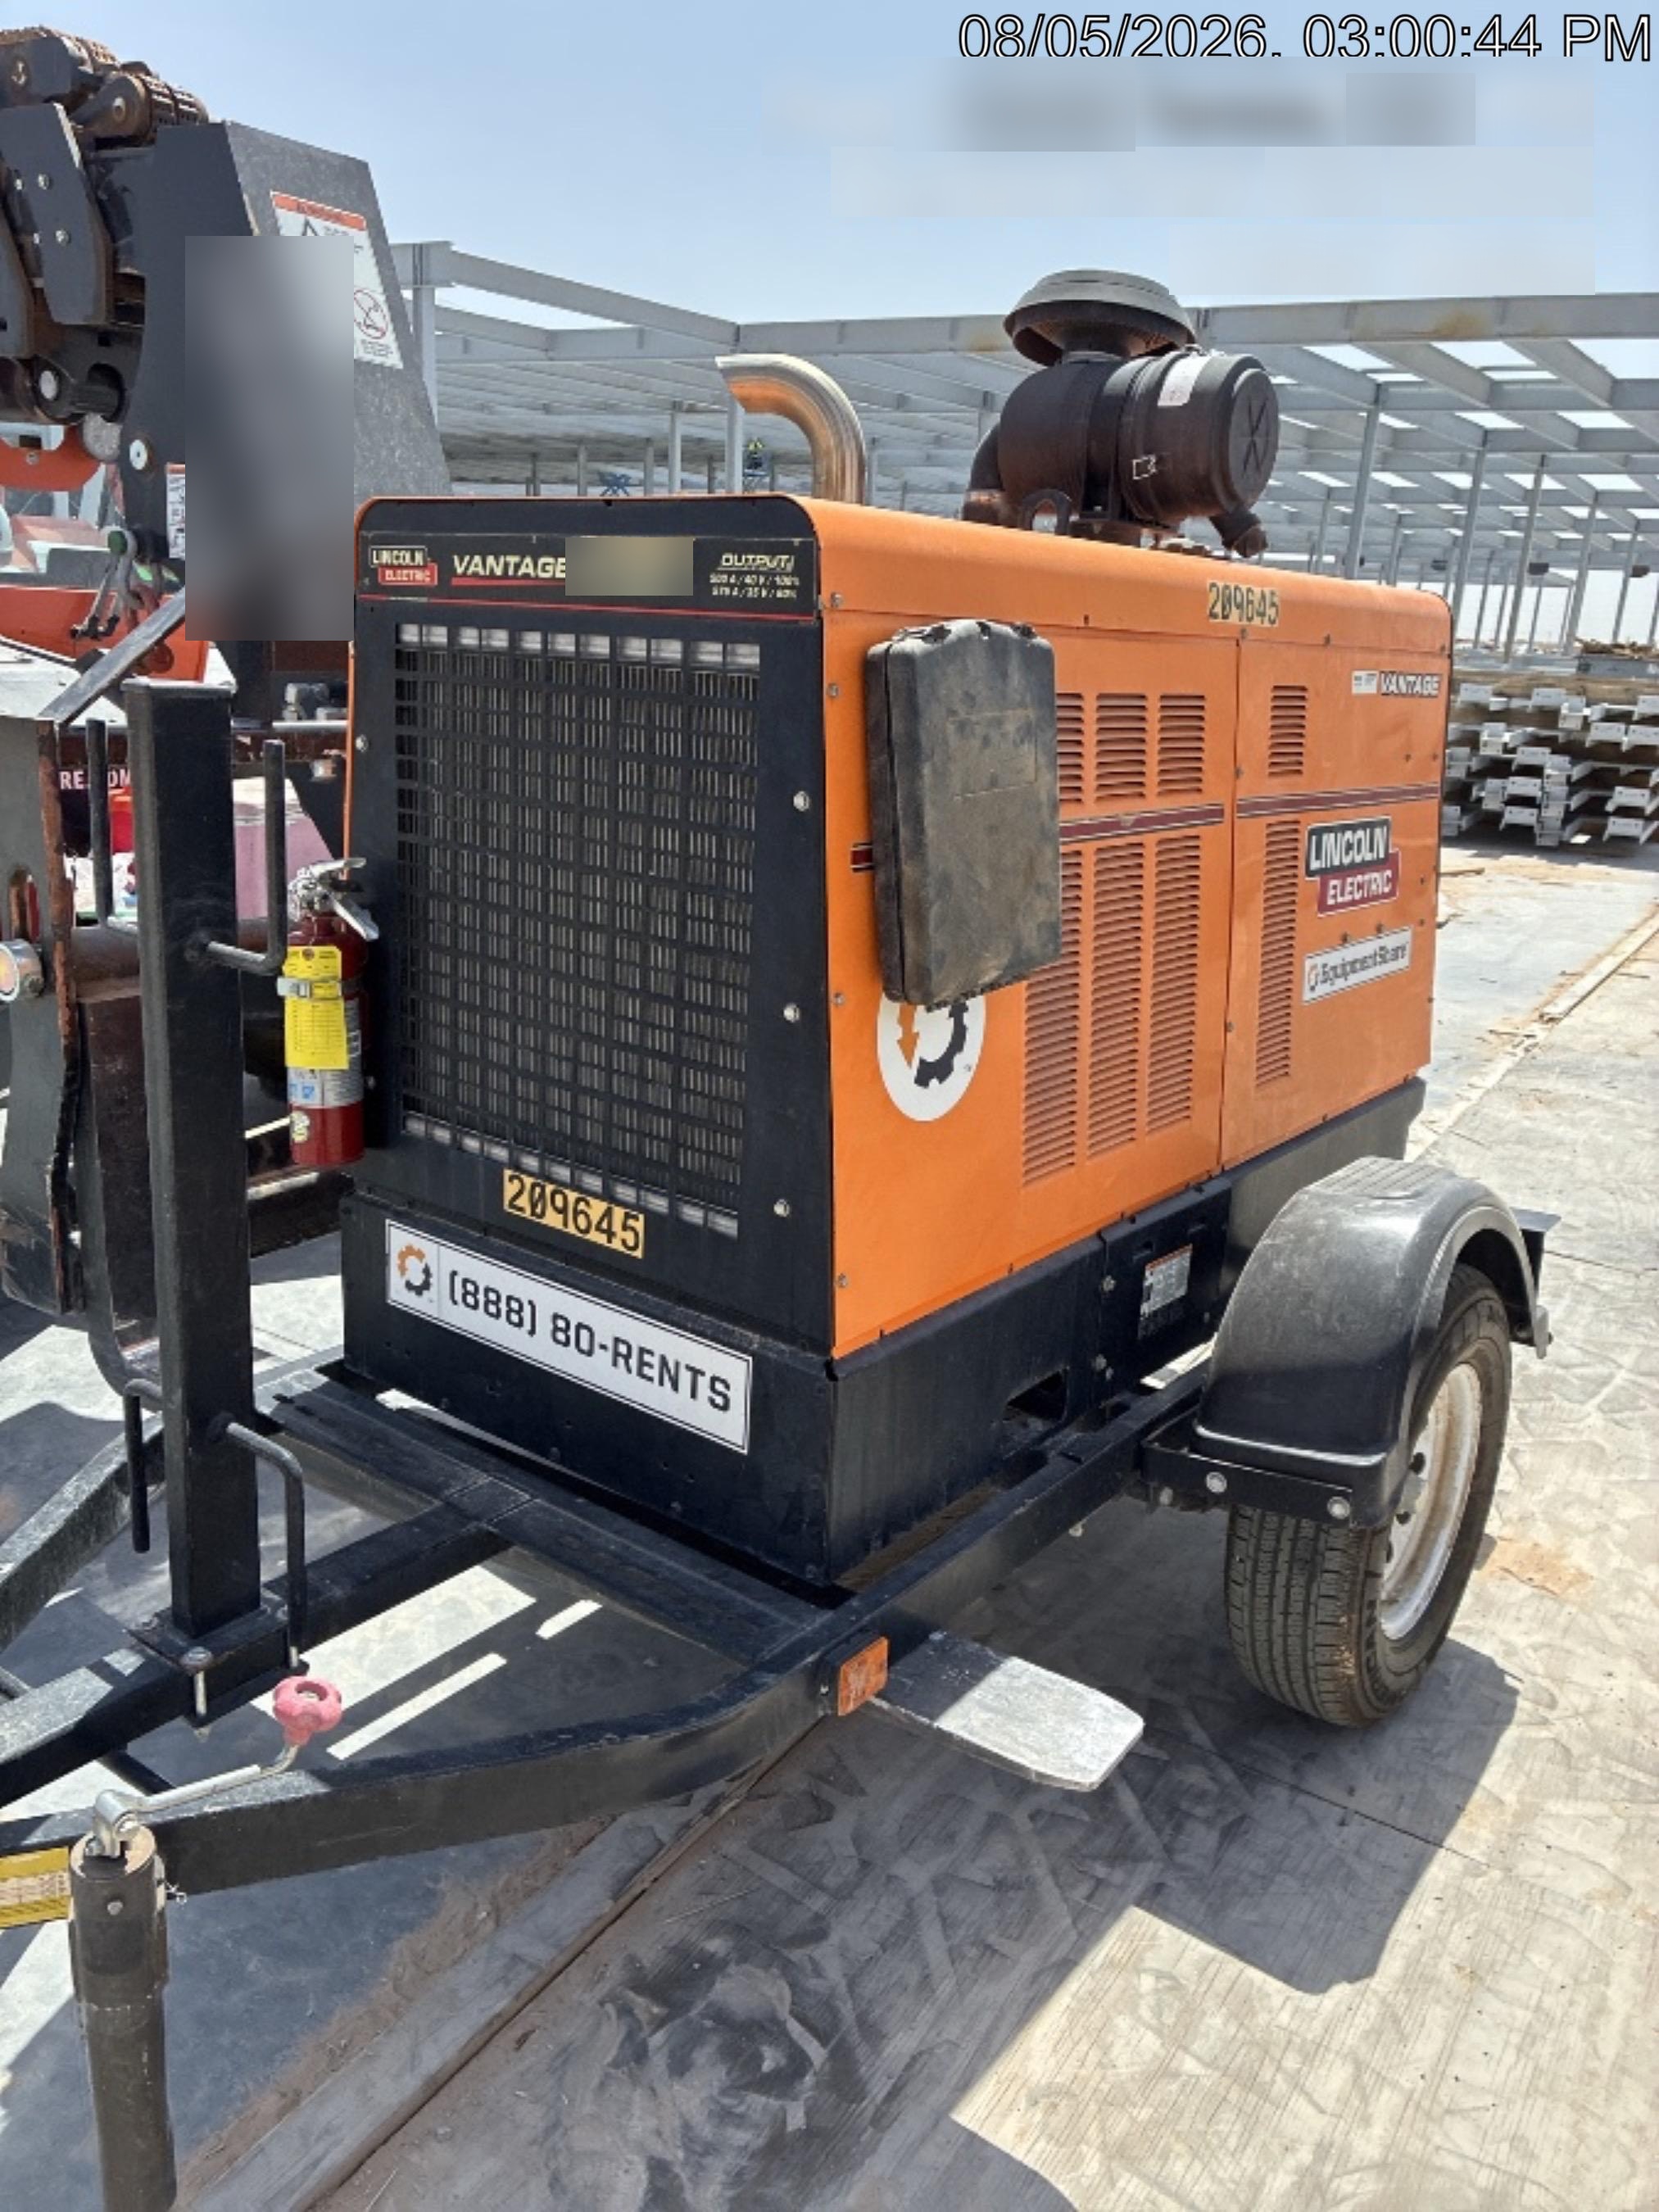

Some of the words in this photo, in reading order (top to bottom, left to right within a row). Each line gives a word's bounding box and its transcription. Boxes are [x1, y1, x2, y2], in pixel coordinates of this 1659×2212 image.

[372, 549, 424, 566] LINCOLN
[384, 569, 431, 582] ELECTRIC
[453, 555, 565, 578] VANTAGE
[721, 552, 791, 569] OUTPUT
[1208, 581, 1279, 625] 209645
[1380, 672, 1442, 697] VANTAGE
[1309, 825, 1387, 871] LINCOLN
[1326, 869, 1393, 906] ELECTRIC
[1320, 944, 1407, 986] EquipmentShare
[507, 1174, 641, 1252] 209645
[449, 1270, 537, 1337] (888)
[551, 1312, 732, 1412] 80-RENTS
